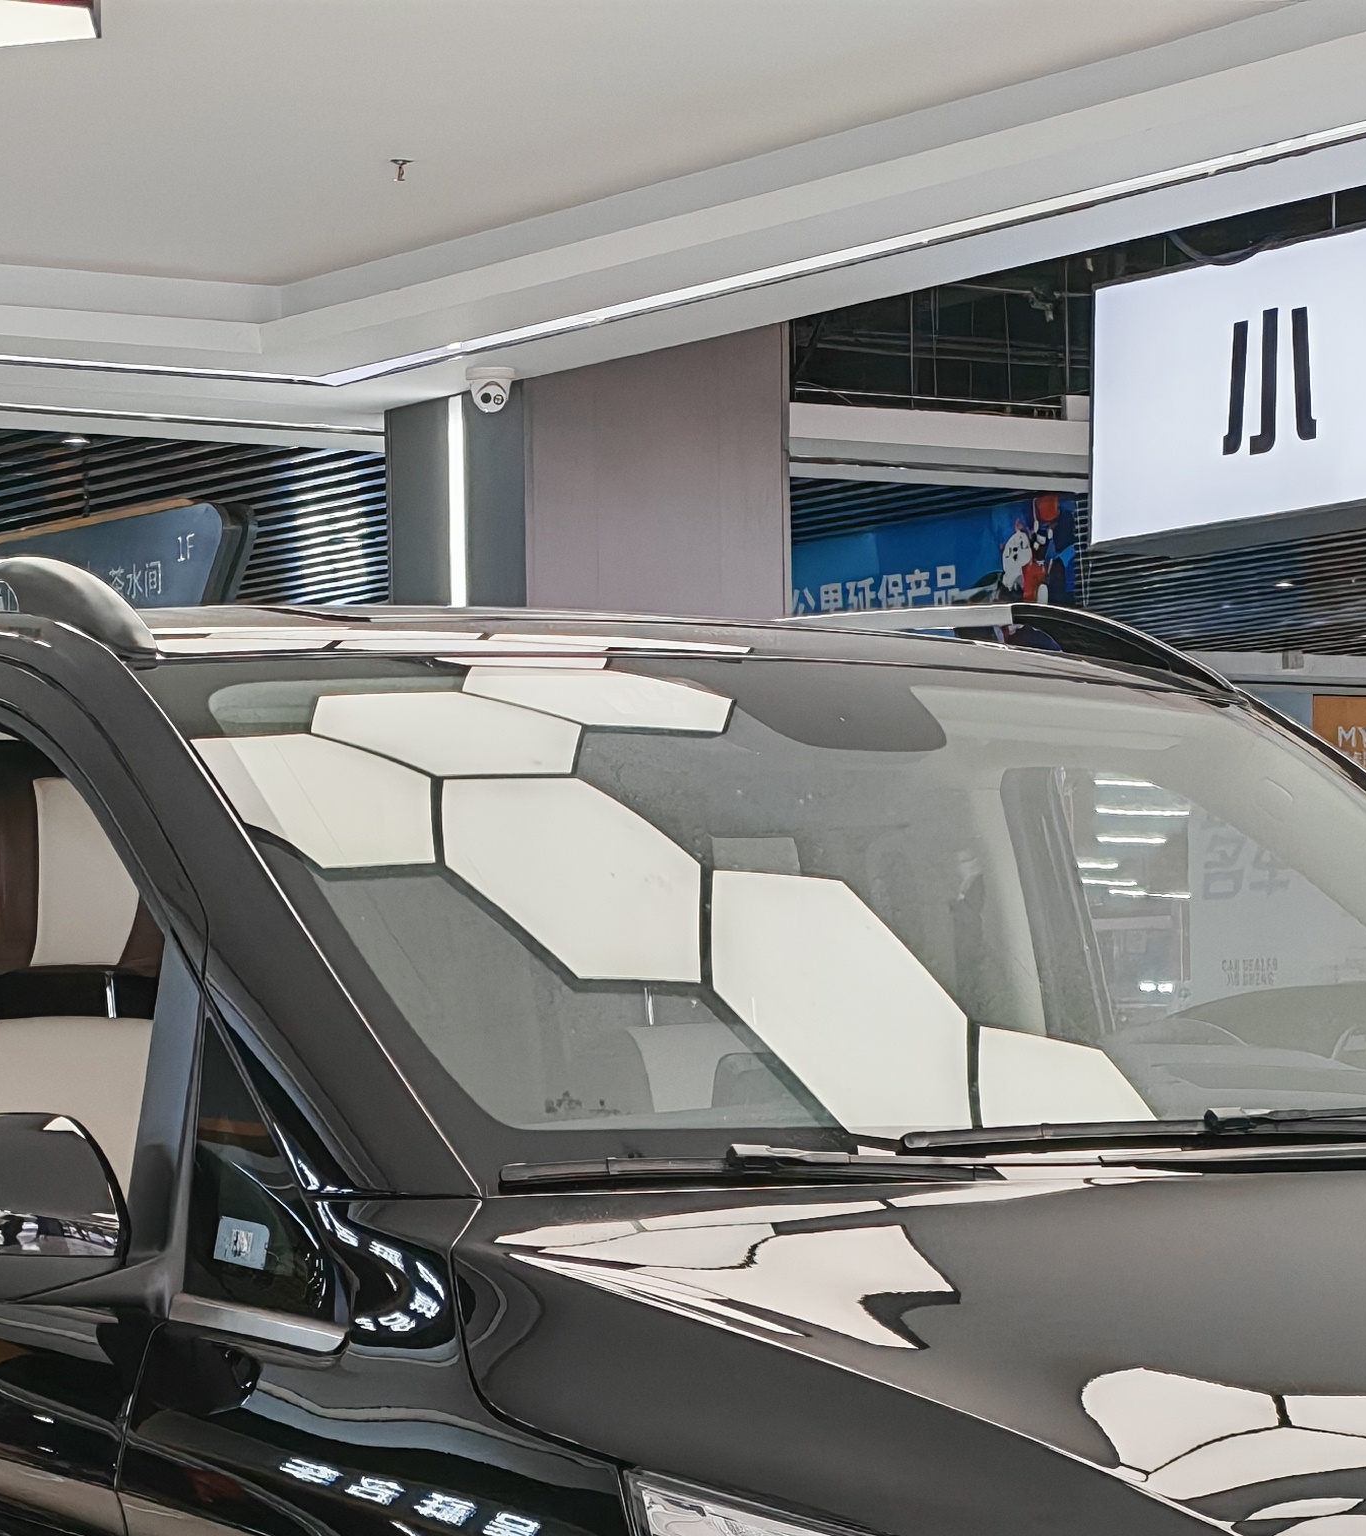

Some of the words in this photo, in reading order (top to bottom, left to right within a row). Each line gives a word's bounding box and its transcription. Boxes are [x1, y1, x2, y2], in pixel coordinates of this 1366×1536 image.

[176, 533, 195, 562] 1F
[109, 560, 163, 601] 茶水间
